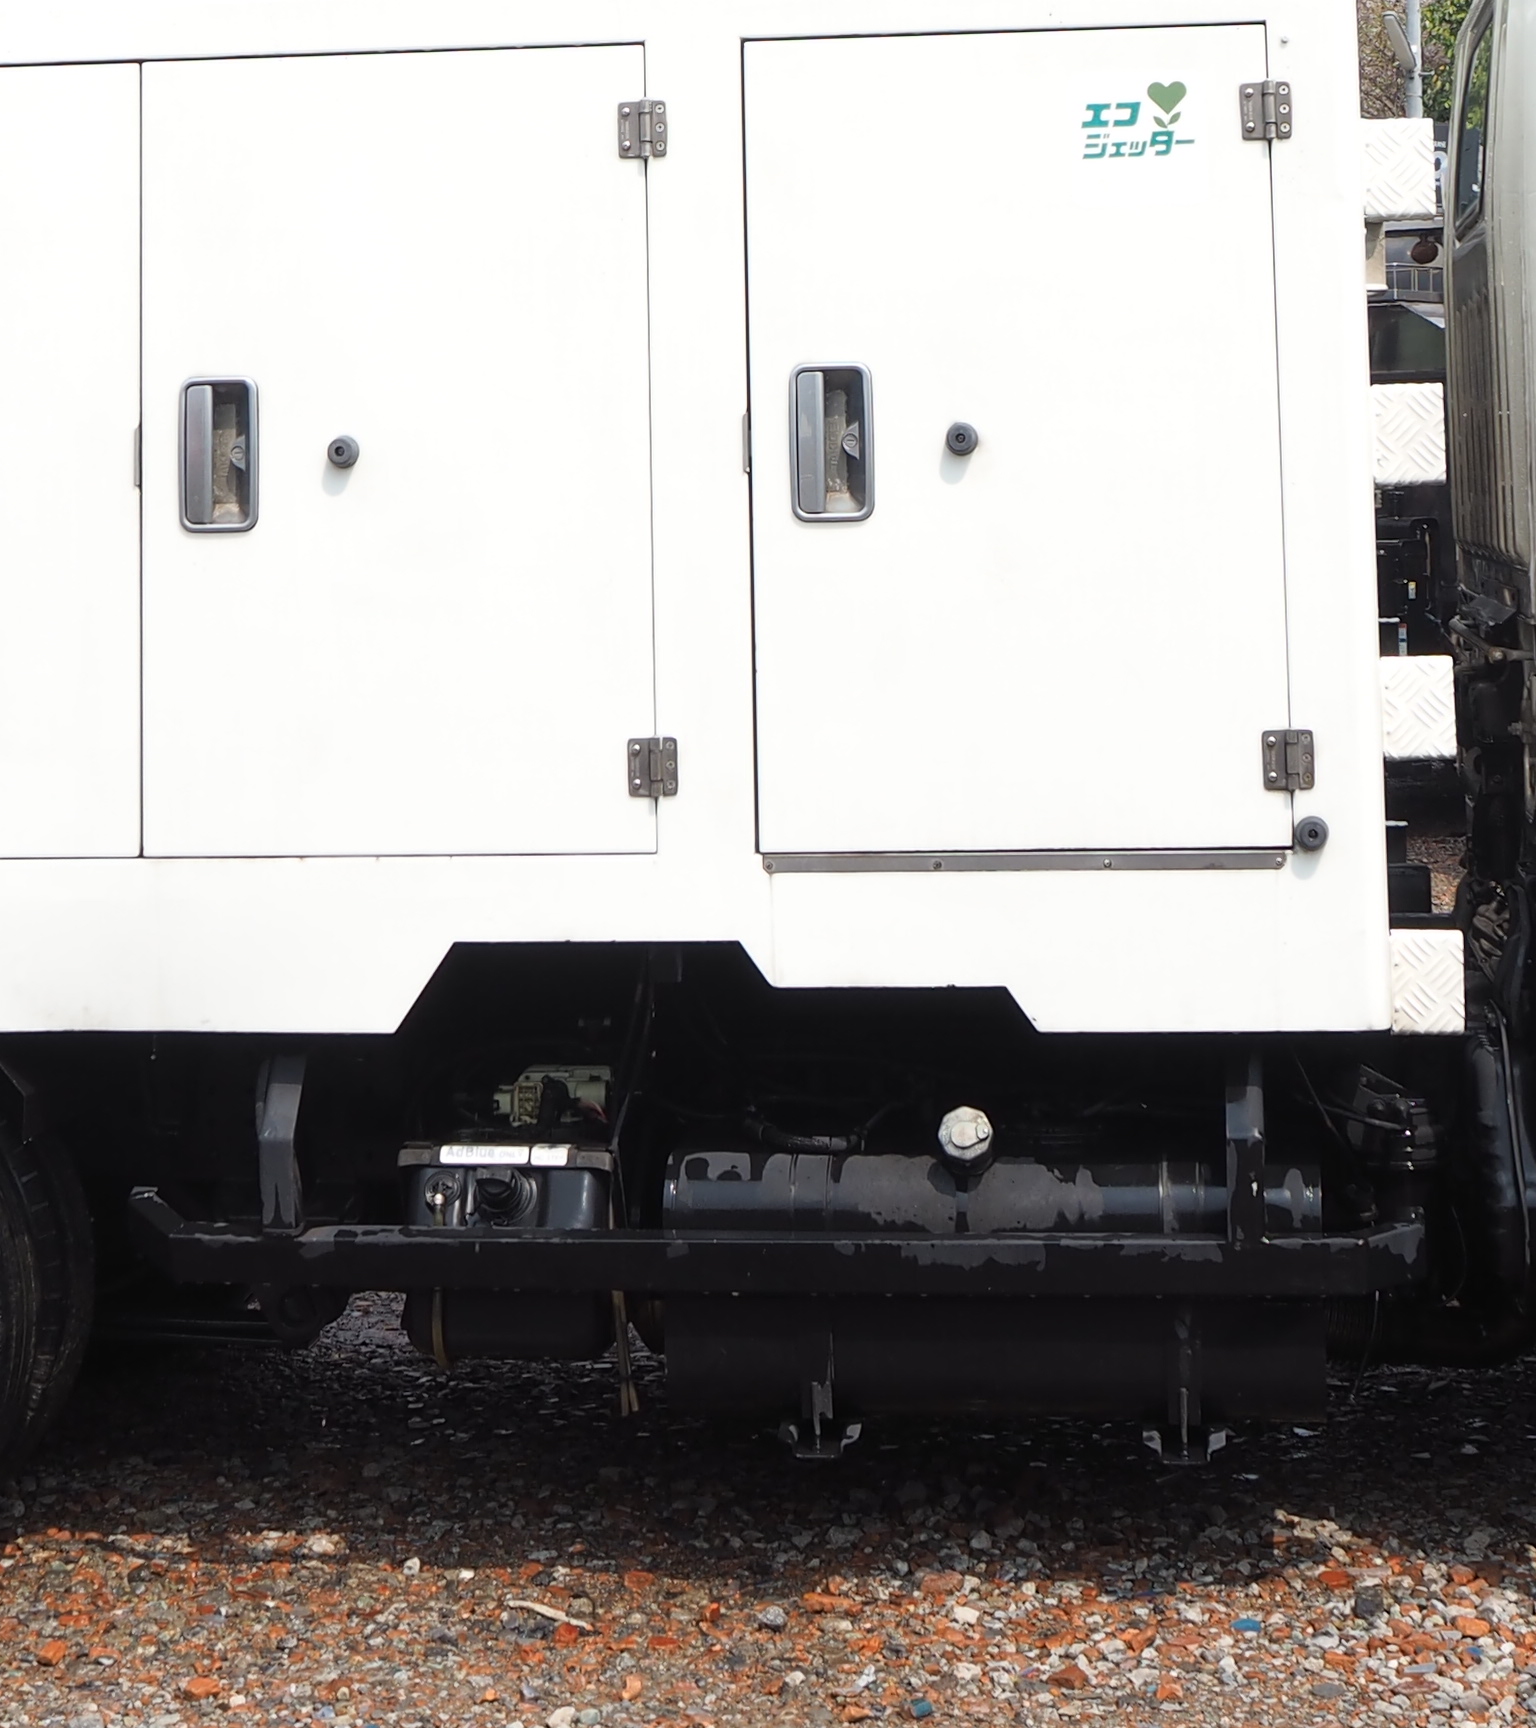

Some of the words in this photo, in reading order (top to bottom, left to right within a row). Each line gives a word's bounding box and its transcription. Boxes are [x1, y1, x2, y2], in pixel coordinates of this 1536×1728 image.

[1081, 101, 1141, 129] エコ
[1082, 130, 1195, 160] ジェッター
[446, 1146, 495, 1158] AdBlue
